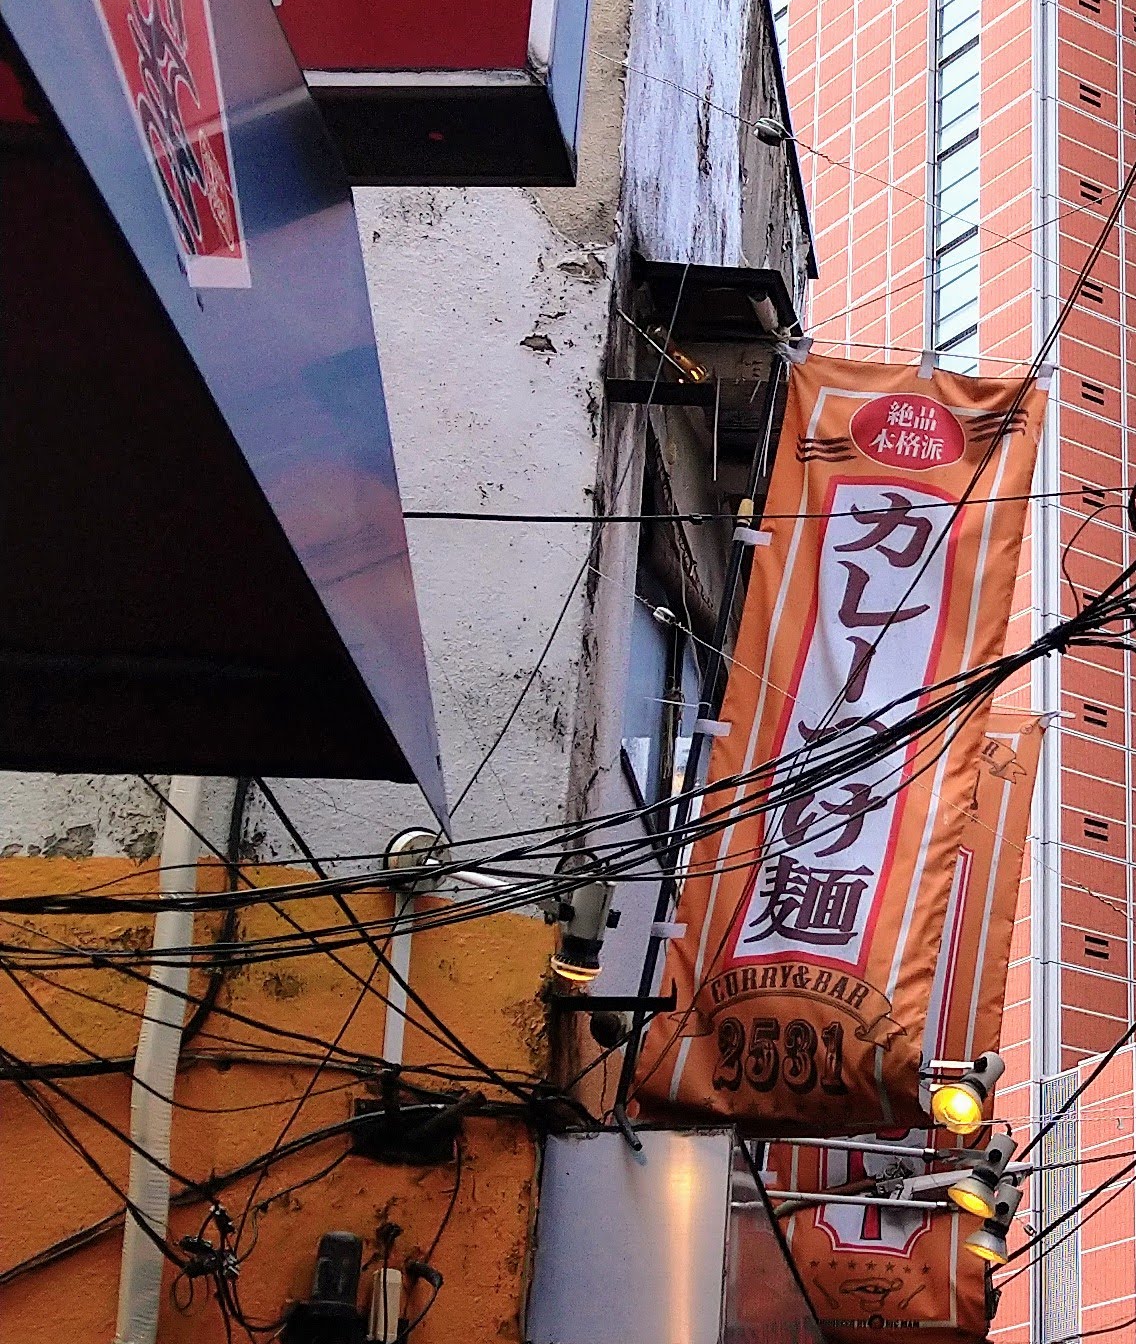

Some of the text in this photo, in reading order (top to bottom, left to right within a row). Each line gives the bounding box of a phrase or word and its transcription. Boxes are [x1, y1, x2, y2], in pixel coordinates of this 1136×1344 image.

[886, 397, 938, 432] 絶品
[868, 427, 945, 464] 本格派
[743, 489, 932, 949] カレーつけ麺
[710, 964, 871, 1010] CURRY&BAR
[711, 1016, 850, 1096] 2531
